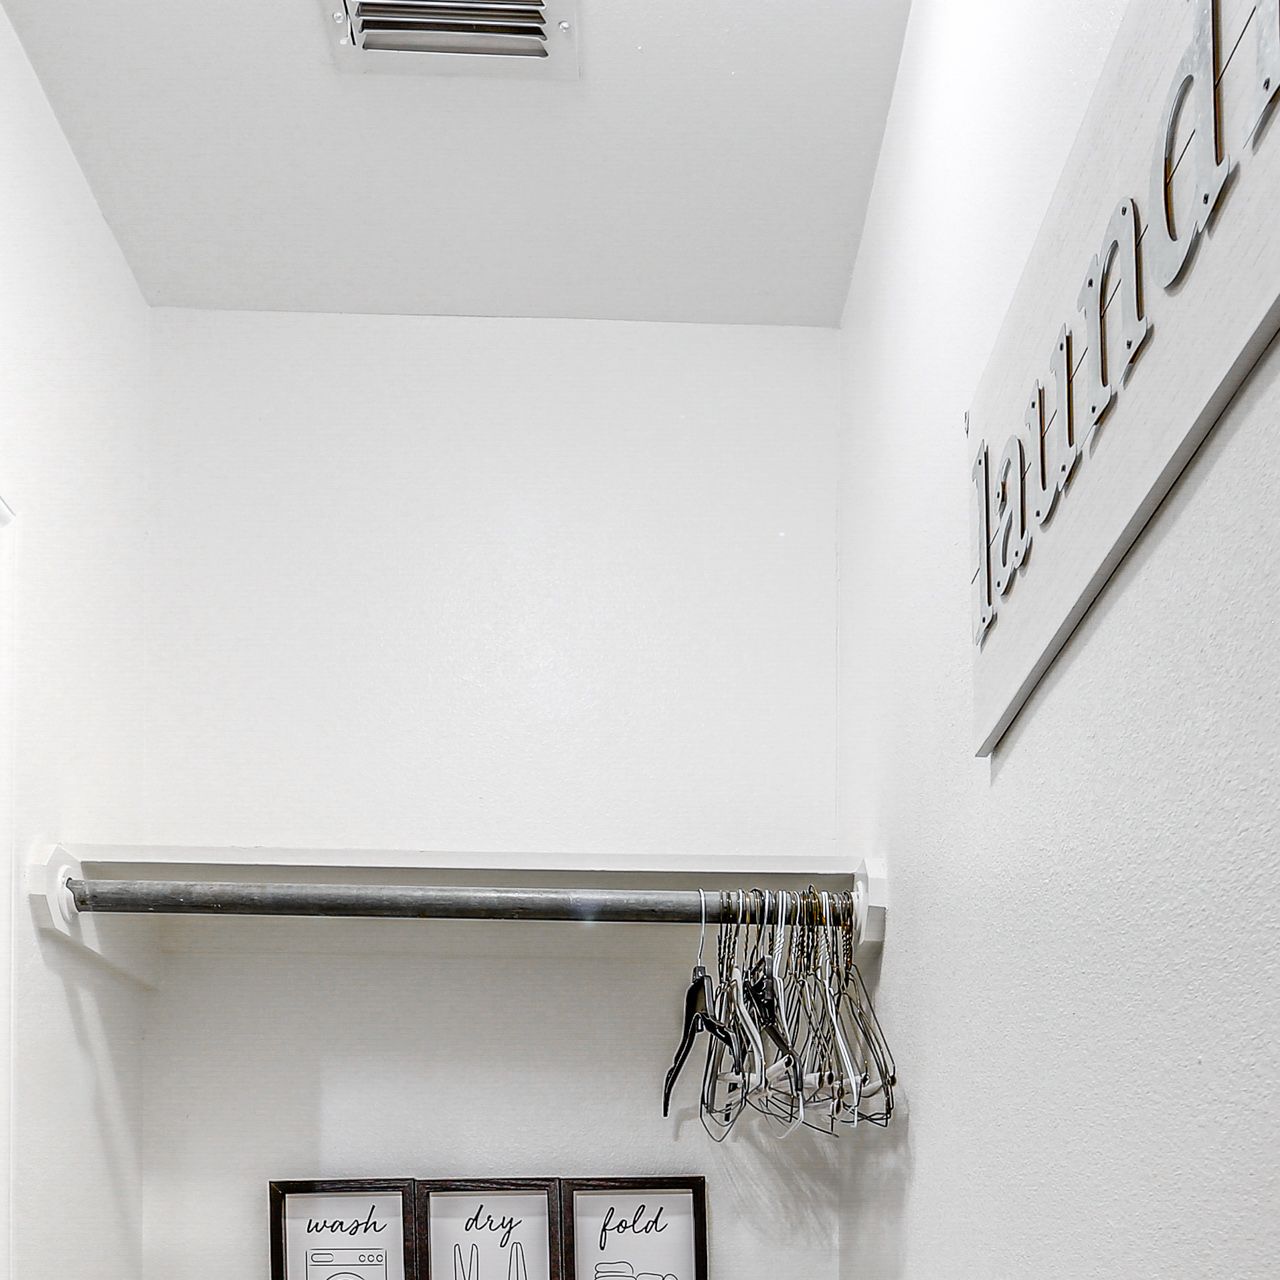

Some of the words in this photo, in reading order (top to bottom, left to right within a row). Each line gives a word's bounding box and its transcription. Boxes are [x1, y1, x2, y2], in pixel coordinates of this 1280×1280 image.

[305, 1203, 390, 1235] wash
[464, 1203, 523, 1248] dry
[598, 1203, 668, 1251] fold
